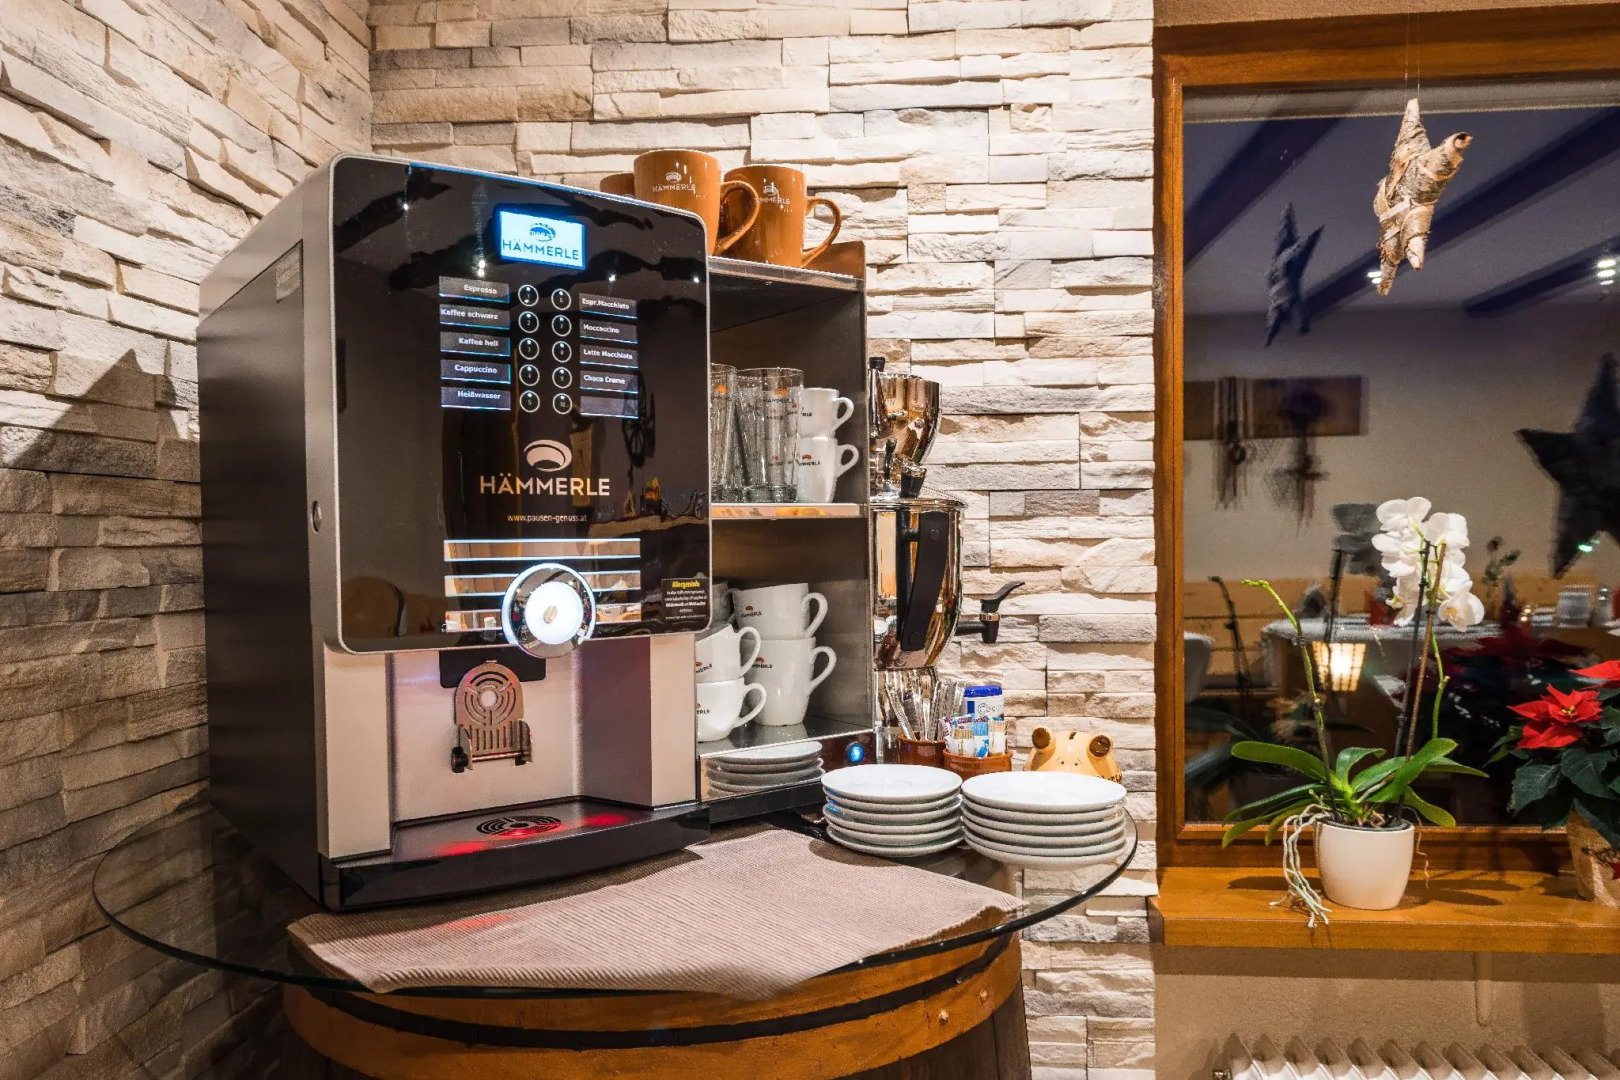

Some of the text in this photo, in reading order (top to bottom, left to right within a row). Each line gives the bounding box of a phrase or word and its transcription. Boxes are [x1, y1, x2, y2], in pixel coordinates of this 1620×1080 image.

[652, 183, 696, 193] HÄMMERLE
[502, 237, 579, 261] HÄMMERLE
[463, 284, 498, 295] Espresso
[440, 308, 499, 320] Kaffee schwarz
[458, 337, 499, 347] Kaffee hell
[583, 348, 633, 361] Latte Macchiato
[454, 363, 498, 376] Cappuccino
[583, 374, 604, 384] Choco
[457, 390, 502, 400] Heißwasser
[480, 472, 610, 496] HÄMMERLE
[507, 513, 587, 524] www.pausen-genuss.at
